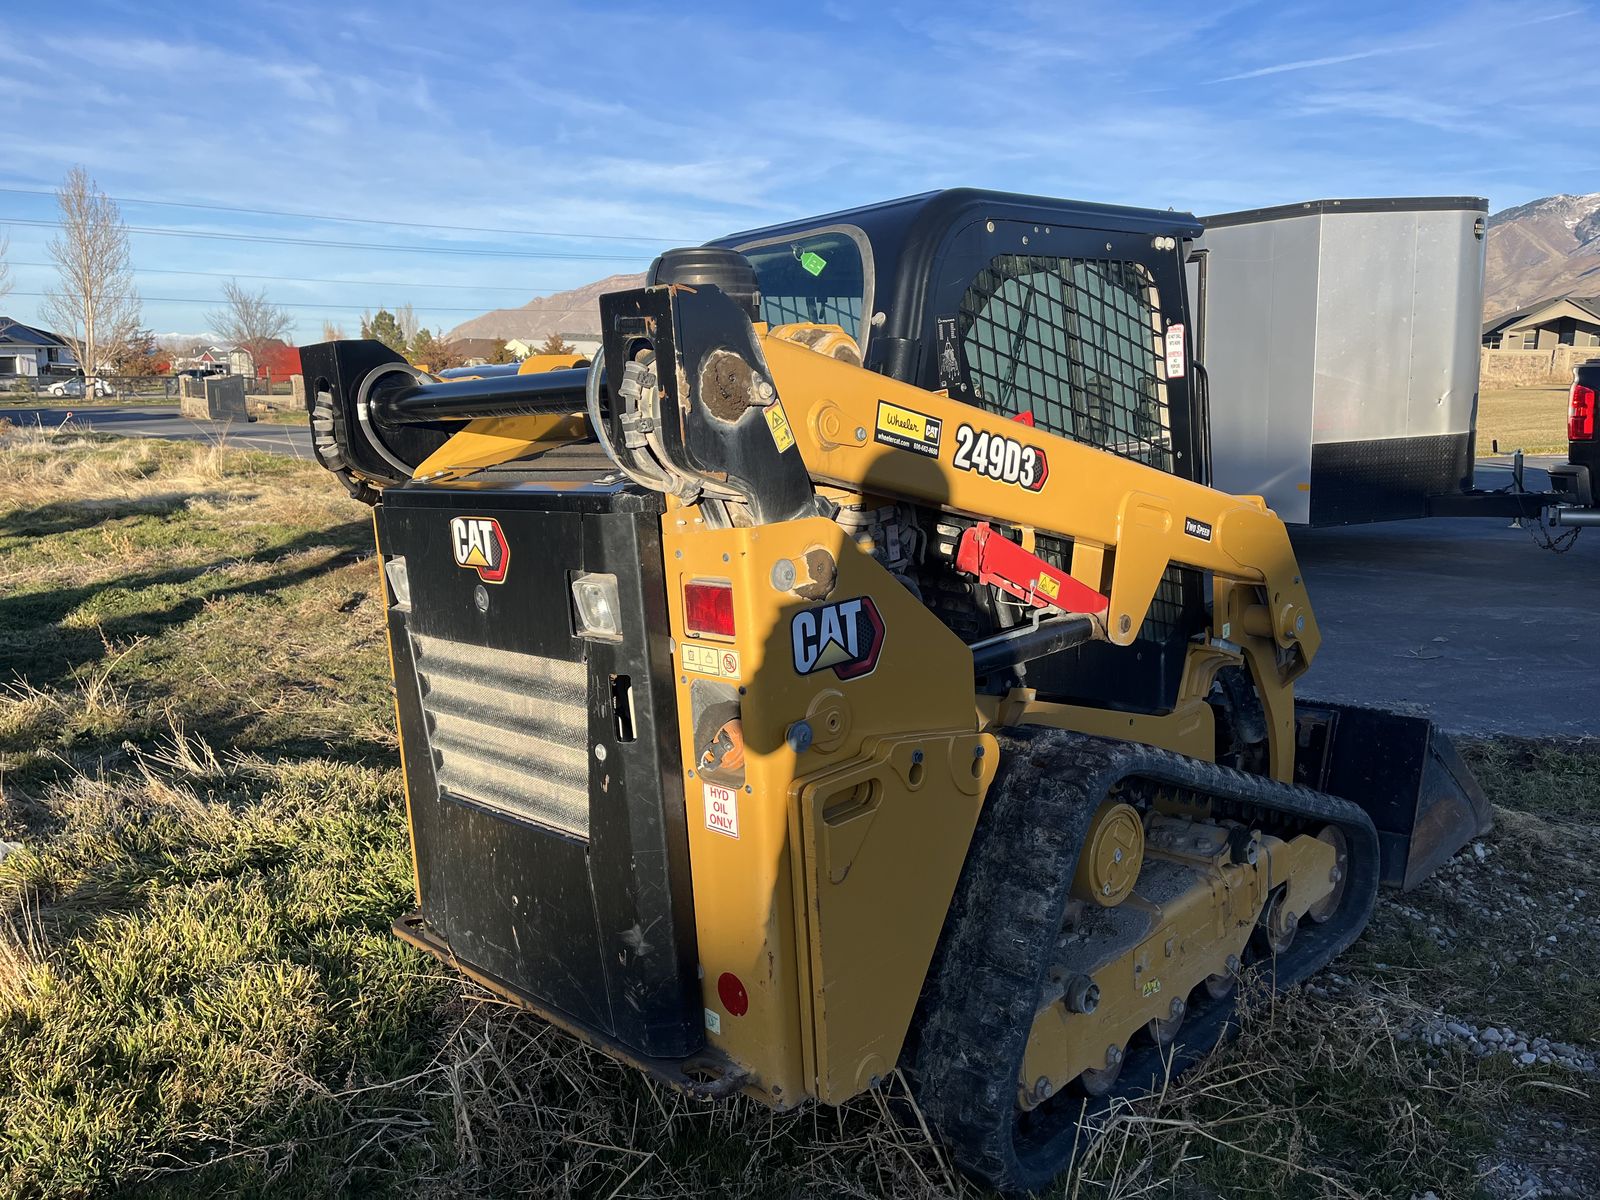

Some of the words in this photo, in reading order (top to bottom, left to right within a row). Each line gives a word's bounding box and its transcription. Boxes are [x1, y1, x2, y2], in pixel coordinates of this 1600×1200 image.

[887, 413, 919, 432] Wheeler
[925, 424, 939, 439] CAT
[878, 433, 910, 447] wheelercat.com
[954, 425, 1036, 488] 249D3
[452, 518, 493, 567] CAT
[792, 599, 862, 673] CAT
[710, 787, 729, 801] HYD
[713, 801, 728, 815] OIL
[710, 813, 733, 830] ONLY
